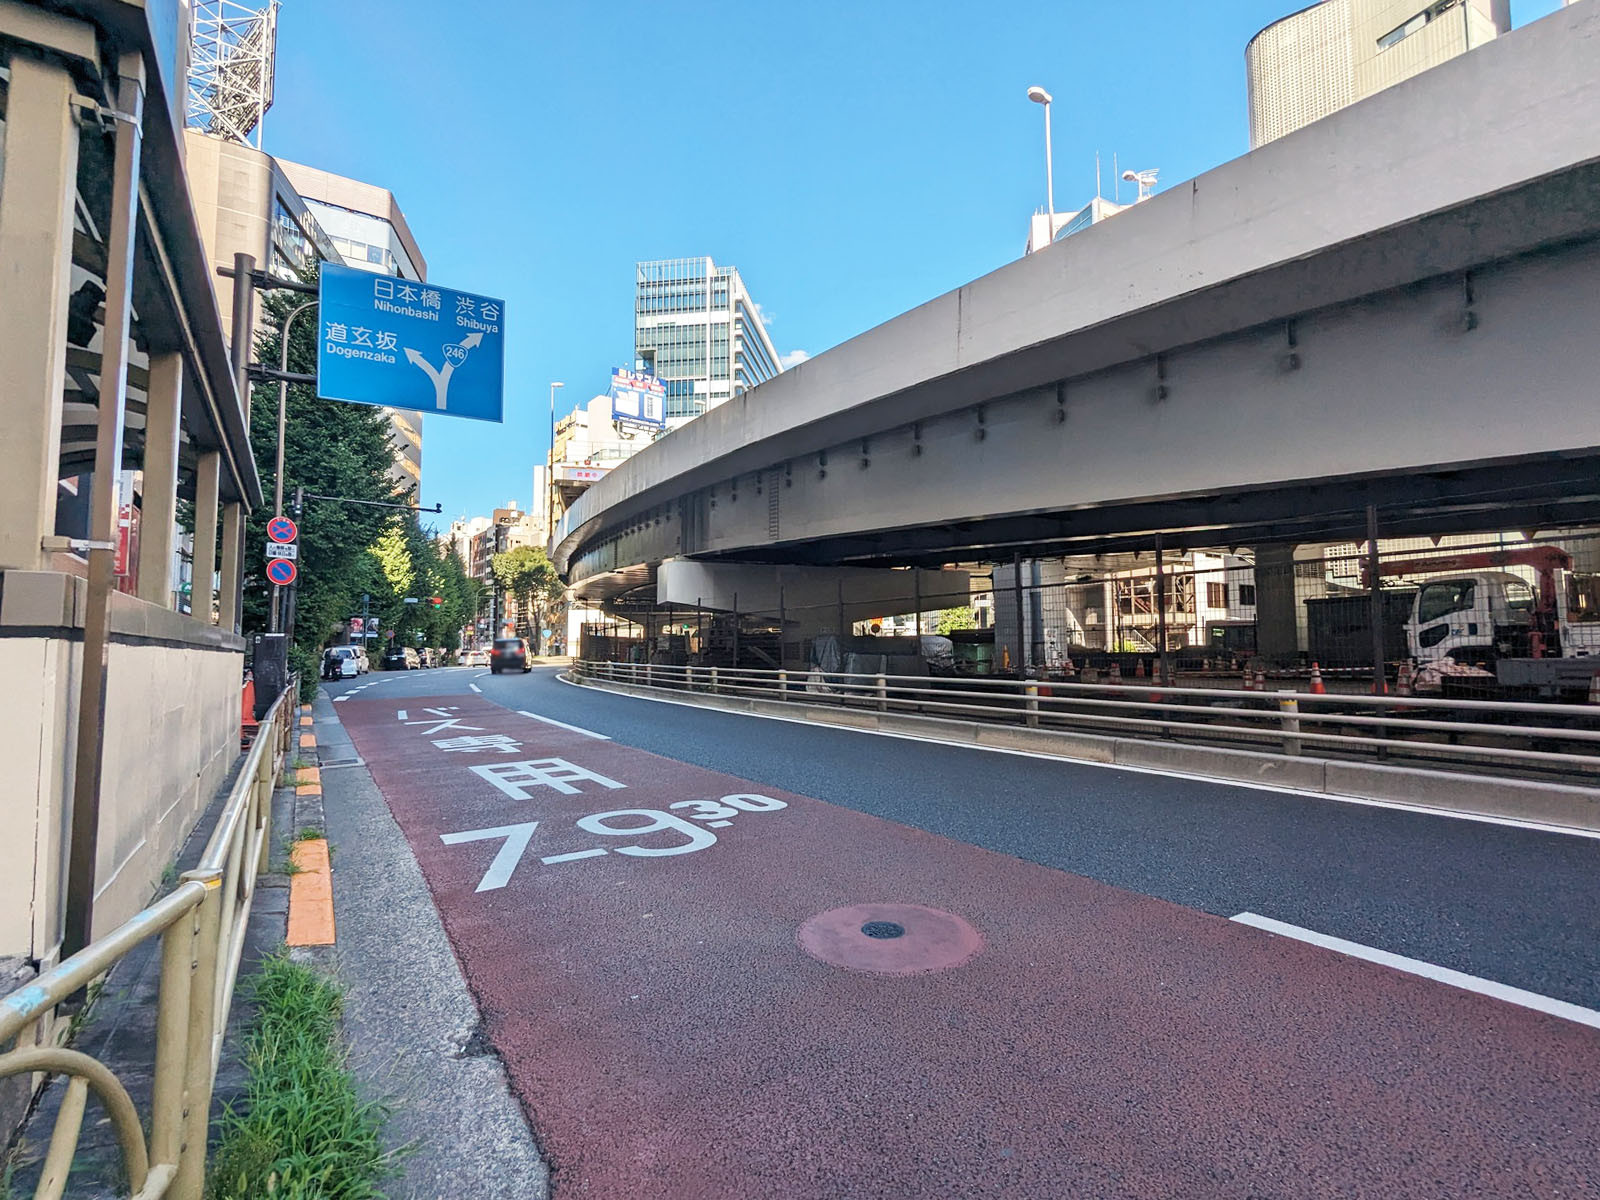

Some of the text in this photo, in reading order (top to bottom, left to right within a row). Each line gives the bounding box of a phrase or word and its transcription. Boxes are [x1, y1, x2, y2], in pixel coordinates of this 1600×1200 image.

[374, 278, 442, 310] 日本橋
[374, 299, 440, 322] Nihonbashi
[455, 296, 500, 322] 渋谷
[456, 315, 499, 334] Shibuya
[325, 321, 398, 352] 道玄坂
[326, 343, 396, 364] Dogenzaka
[446, 346, 465, 360] 246
